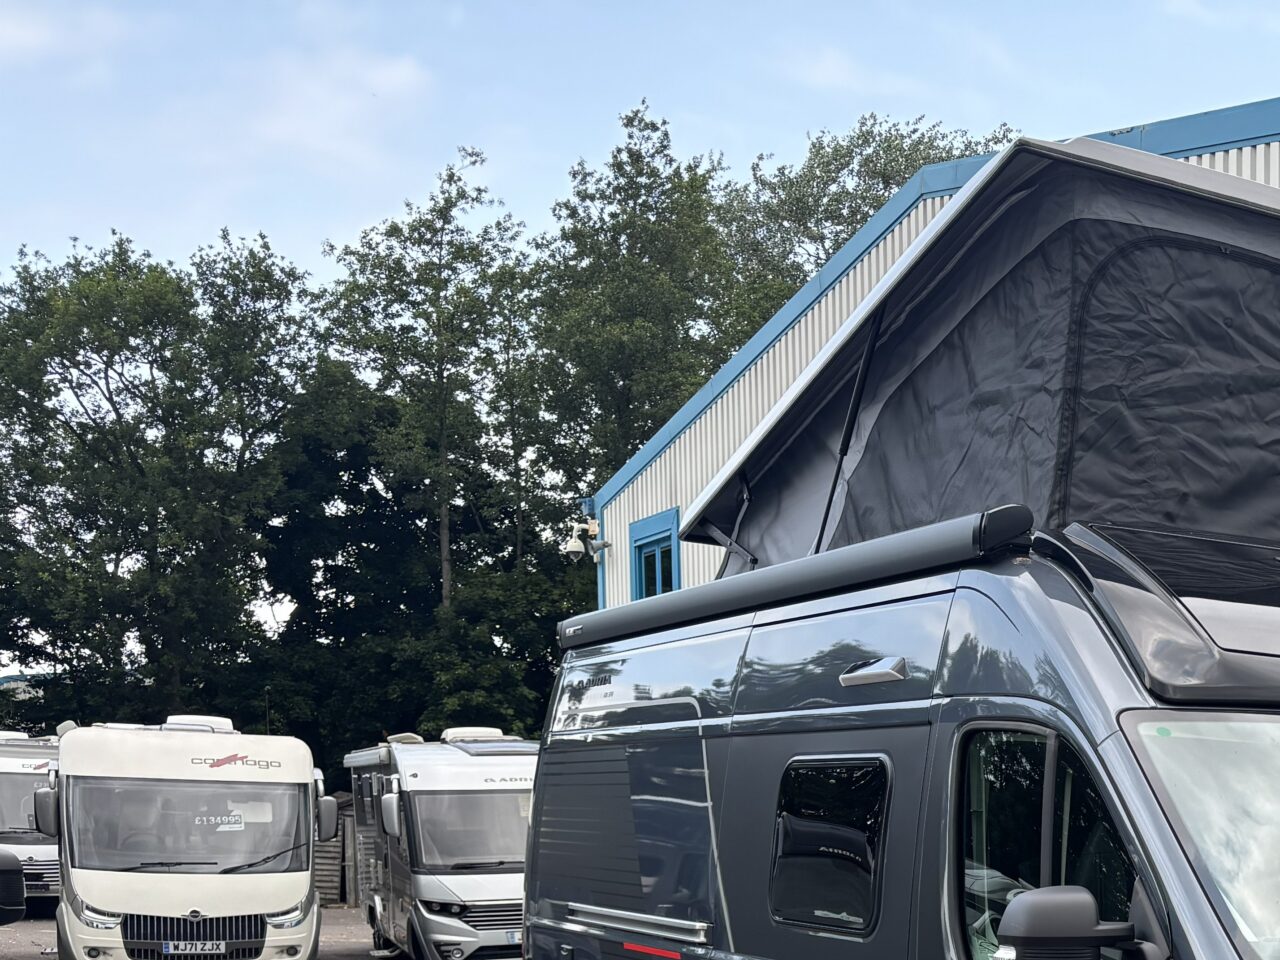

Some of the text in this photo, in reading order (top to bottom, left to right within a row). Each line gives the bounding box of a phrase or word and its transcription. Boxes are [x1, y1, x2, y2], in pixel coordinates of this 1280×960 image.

[191, 755, 281, 769] cahago
[194, 815, 241, 825] £134995
[173, 942, 221, 952] WJ71 ZJX
